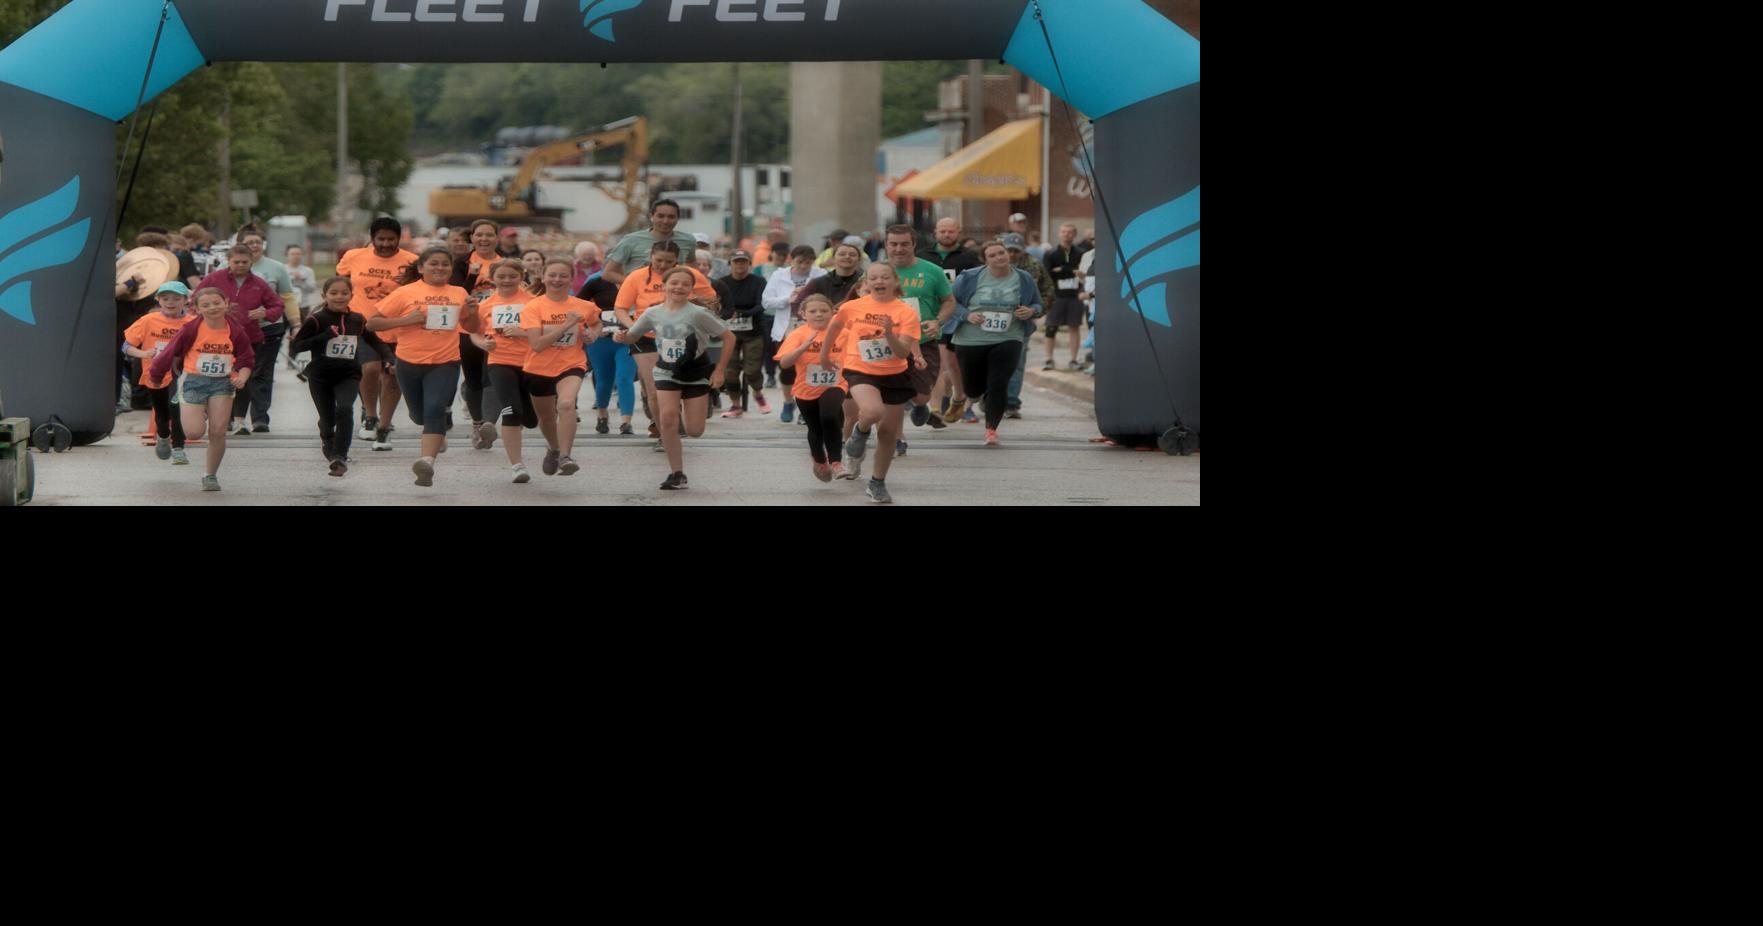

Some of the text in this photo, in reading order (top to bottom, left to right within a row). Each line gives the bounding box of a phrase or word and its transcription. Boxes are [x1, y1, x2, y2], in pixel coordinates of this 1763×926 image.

[441, 314, 449, 326] 1
[497, 313, 521, 324] 724
[985, 318, 1007, 330] 336
[332, 343, 355, 356] 571
[865, 346, 892, 360] 134
[201, 361, 226, 374] 551
[812, 372, 836, 384] 132
